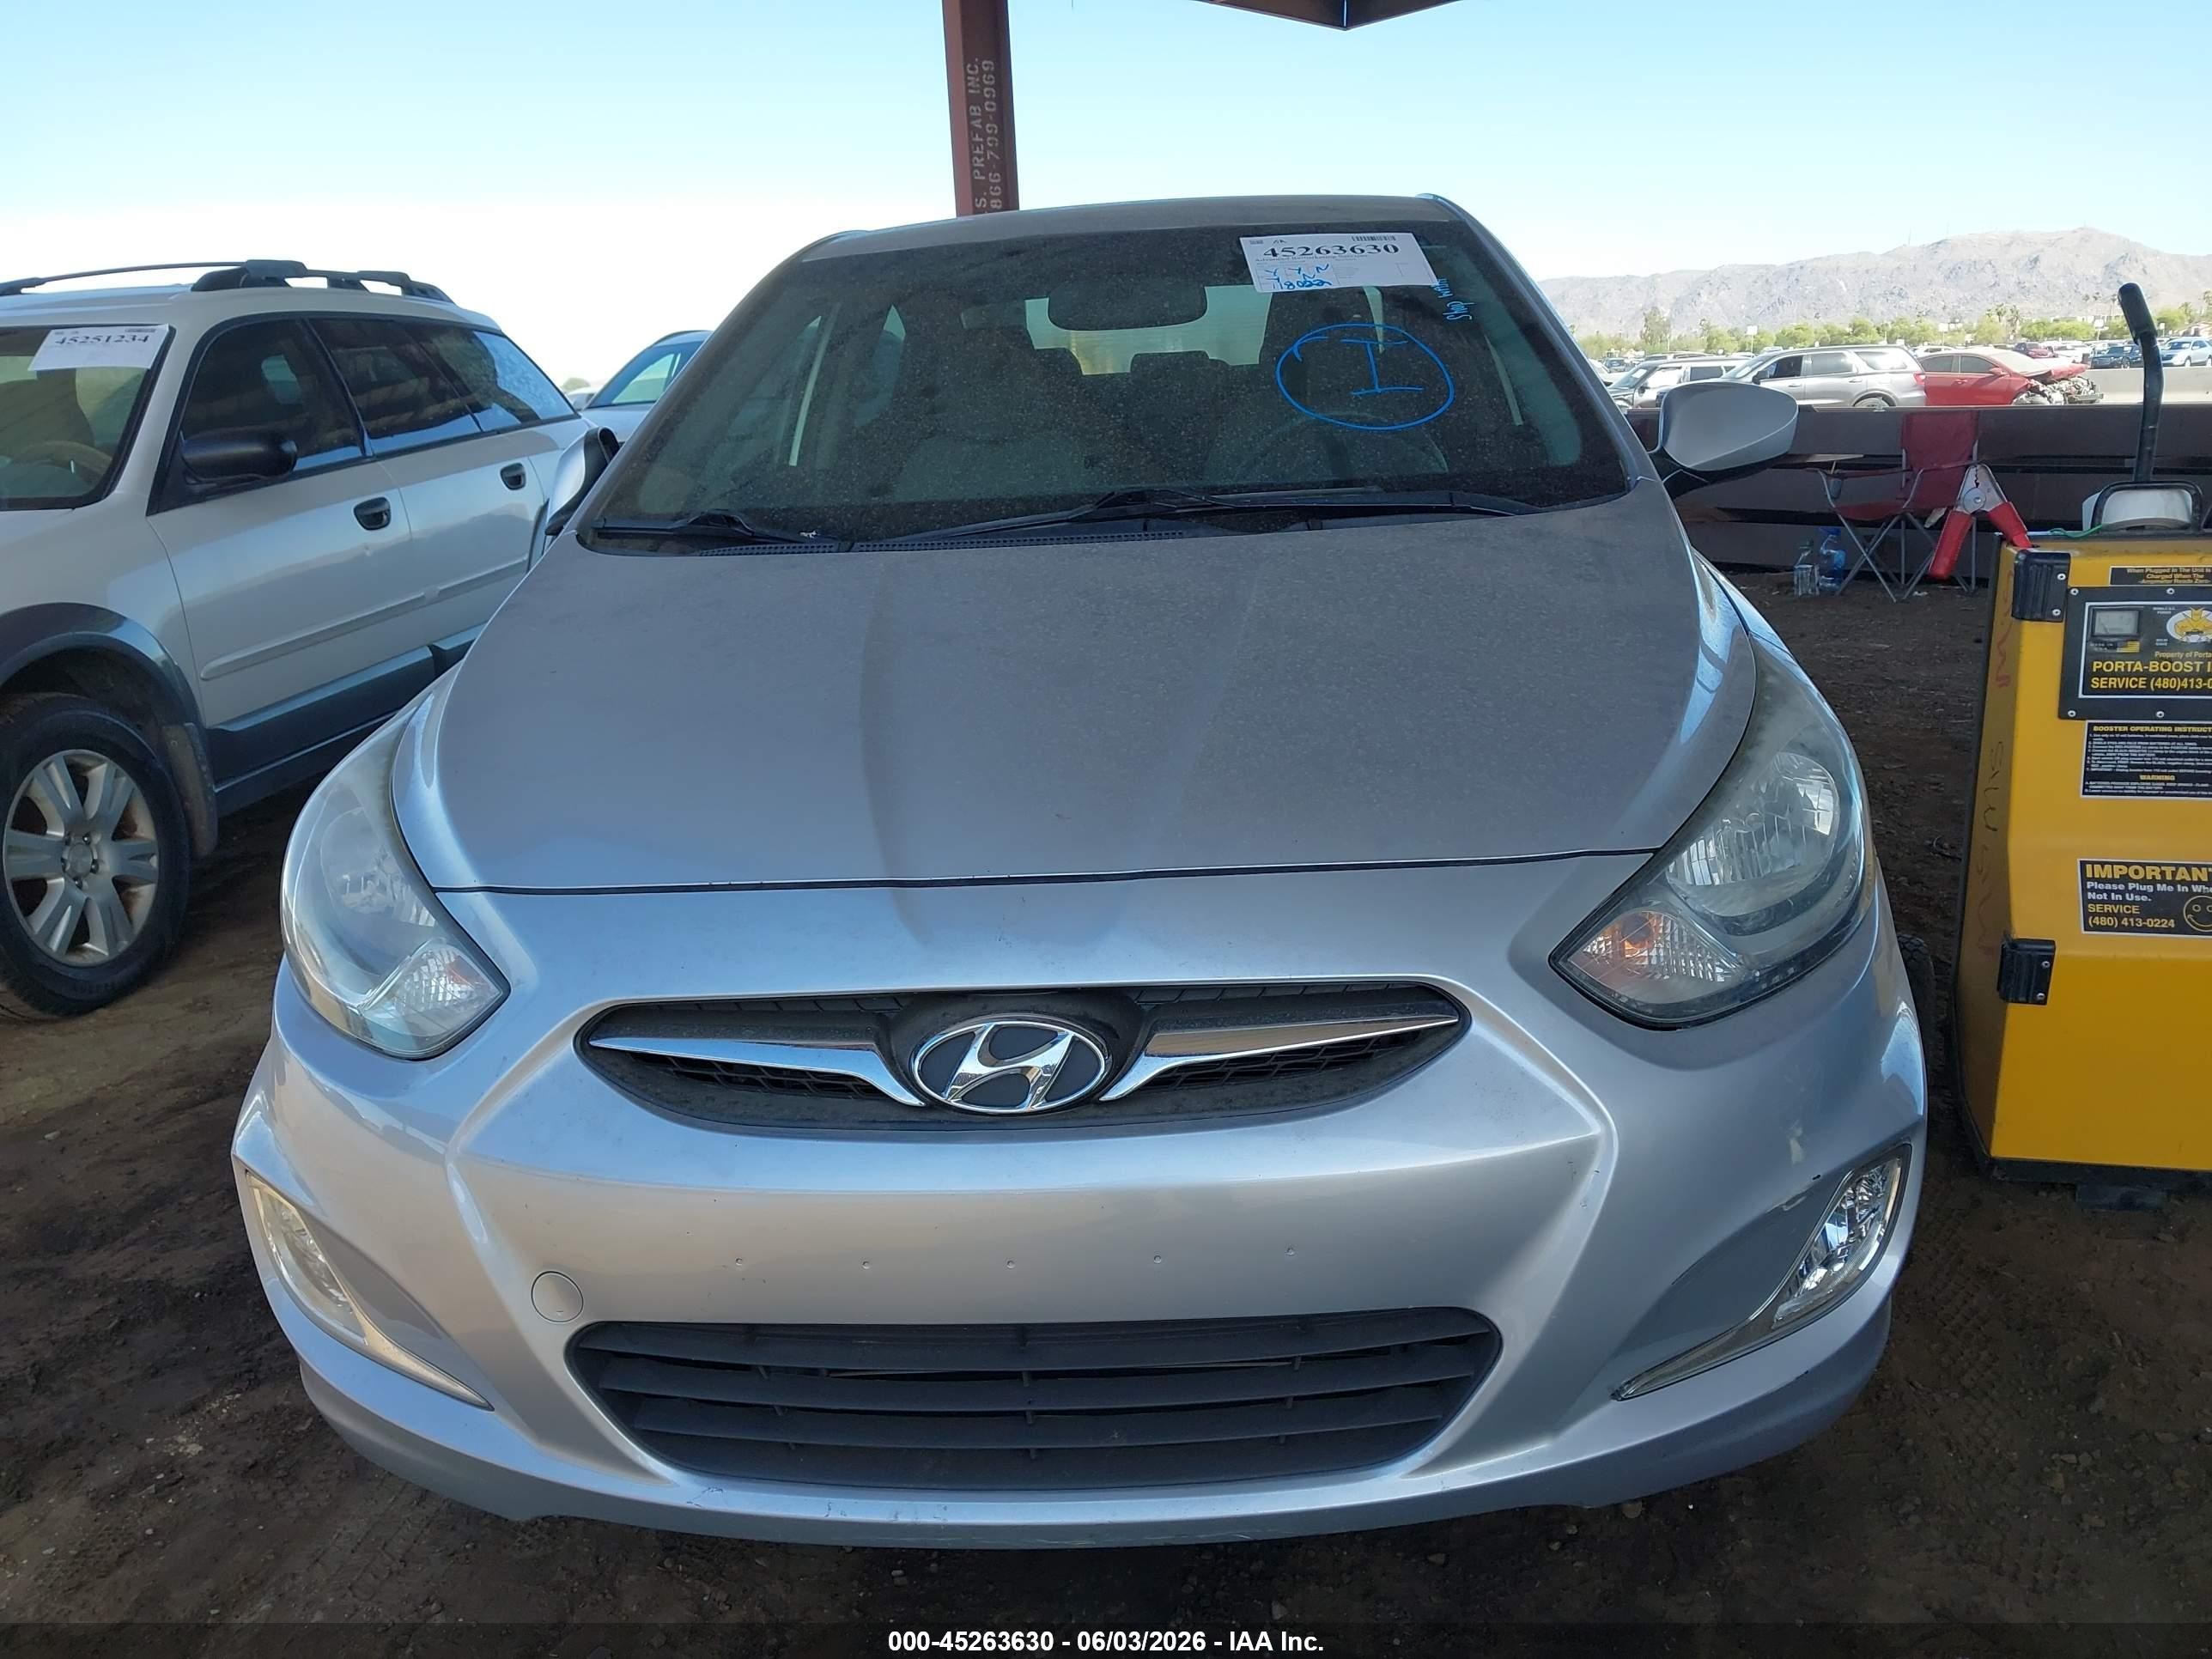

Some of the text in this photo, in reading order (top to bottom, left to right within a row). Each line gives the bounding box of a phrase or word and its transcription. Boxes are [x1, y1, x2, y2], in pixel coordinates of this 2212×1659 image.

[966, 58, 981, 94] INC.
[981, 60, 1003, 210] 866-799-0969
[969, 105, 986, 179] PREFAB
[1263, 244, 1399, 258] 45263630
[54, 334, 149, 344] 45251234
[2093, 660, 2203, 672] PORTA-BOOST
[2090, 677, 2147, 689] SERVICE
[2087, 881, 2125, 890] Please
[2128, 882, 2154, 892] Plug
[2156, 884, 2174, 892] Me
[2125, 893, 2152, 902] Use.
[2087, 903, 2141, 915] SERVICE
[2088, 916, 2175, 928] (480) 413-0224
